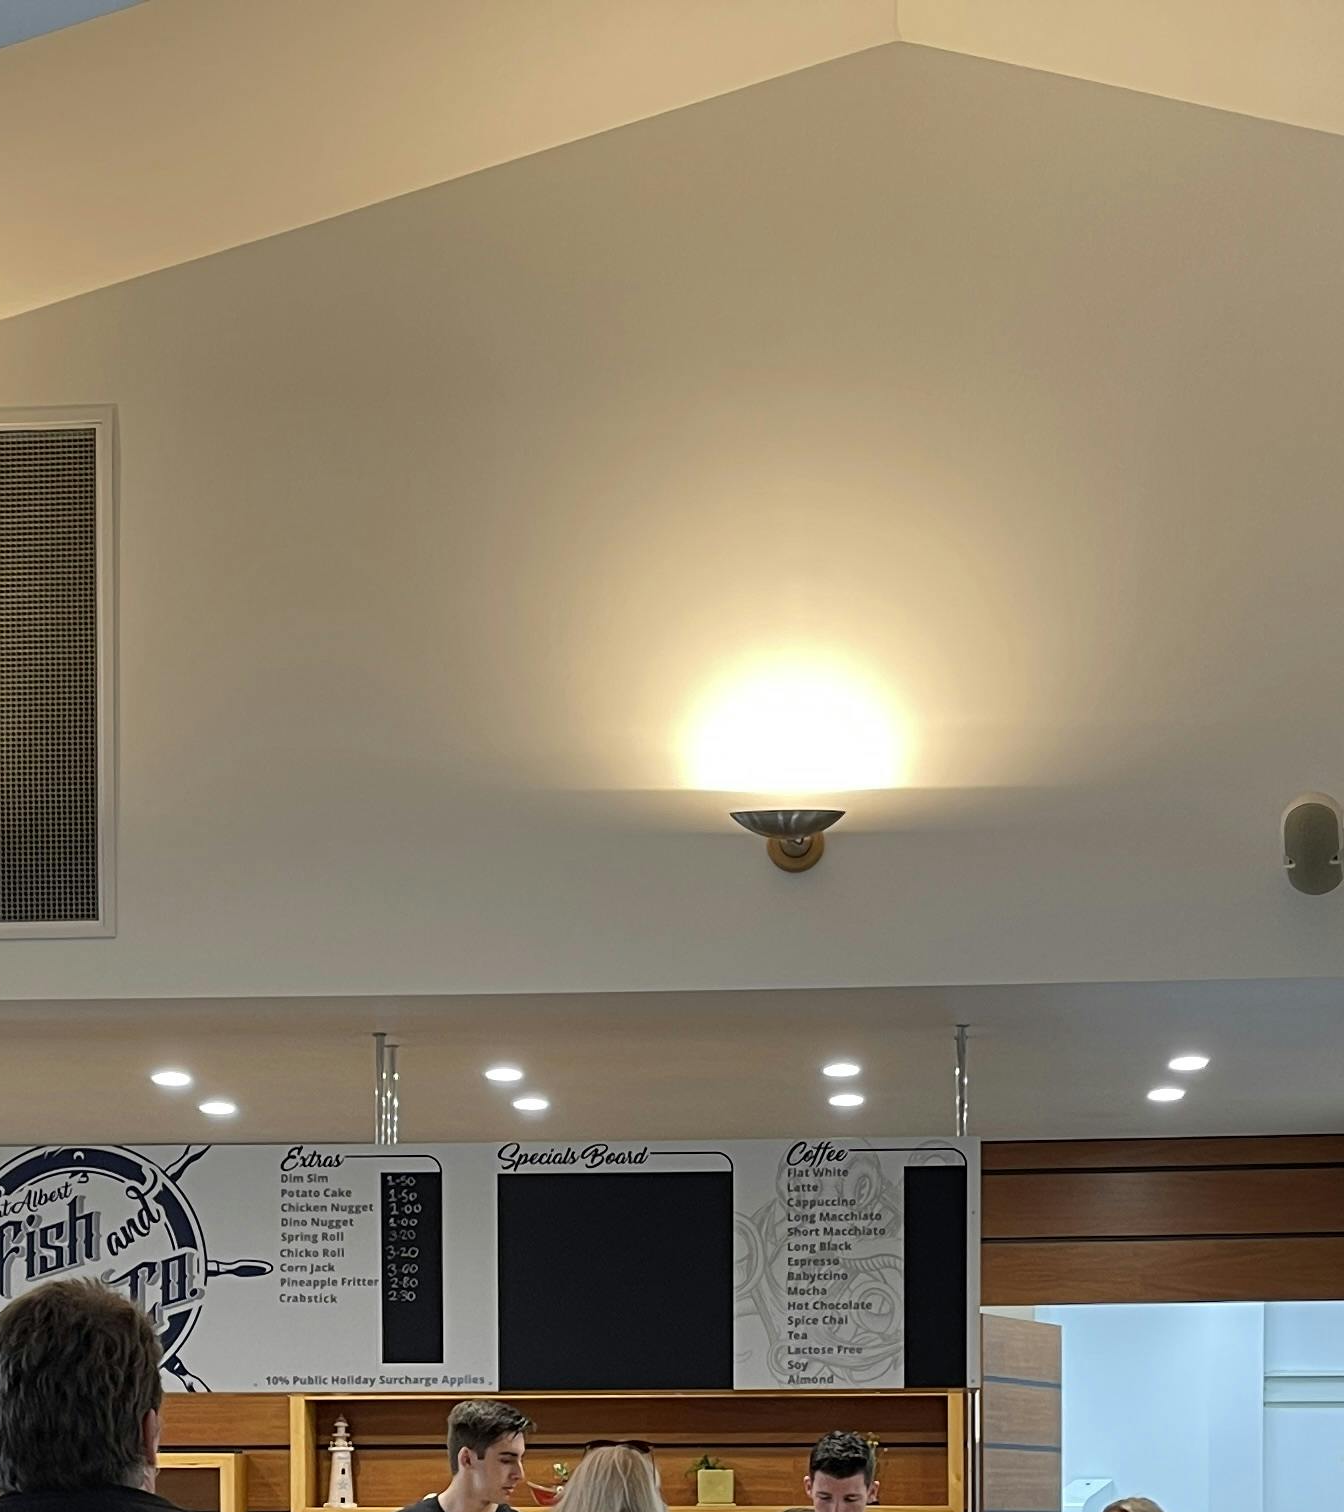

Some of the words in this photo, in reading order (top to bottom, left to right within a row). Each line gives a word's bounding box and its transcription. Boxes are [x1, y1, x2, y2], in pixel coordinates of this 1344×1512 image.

[280, 1144, 345, 1172] Extras
[497, 1142, 580, 1172] Specials
[580, 1143, 648, 1168] Board
[786, 1141, 849, 1167] Coffee
[280, 1174, 304, 1183] Dim
[307, 1174, 329, 1183] Sim
[787, 1168, 810, 1177] Flat
[813, 1168, 849, 1177] White
[280, 1189, 320, 1198] Potato
[323, 1188, 352, 1198] Cake
[787, 1183, 818, 1193] Latte
[10, 1181, 72, 1212] Albert
[280, 1203, 327, 1212] Chicken
[331, 1203, 374, 1215] Nugget
[787, 1197, 856, 1209] Cappuccino
[106, 1167, 162, 1256] and
[280, 1218, 307, 1227] Dino
[311, 1218, 354, 1229] Nugget
[787, 1212, 816, 1224] Long
[819, 1212, 882, 1221] Macchiato
[787, 1227, 820, 1237] Short
[823, 1226, 886, 1236] Macchiato
[280, 1232, 318, 1244] Spring
[321, 1232, 344, 1241] Roll
[280, 1249, 319, 1258] Chicko
[322, 1249, 344, 1258] Roll
[787, 1242, 816, 1254] Long
[819, 1241, 852, 1251] Black
[787, 1257, 840, 1268] Espresso
[280, 1263, 307, 1272] Corn
[310, 1263, 335, 1275] Jack
[280, 1278, 338, 1289] Pineapple
[341, 1277, 379, 1287] Fritter
[787, 1271, 849, 1284] Babyccino
[787, 1286, 827, 1296] Mocha
[279, 1293, 338, 1303] Crabstick
[787, 1301, 810, 1311] Hot
[812, 1300, 873, 1310] Chocolate
[787, 1315, 818, 1328] Spice
[822, 1315, 848, 1325] Chai
[787, 1331, 808, 1340] Tea
[787, 1345, 834, 1355] Lactose
[837, 1345, 863, 1354] Free
[787, 1360, 808, 1372] Soy
[266, 1375, 289, 1385] 10%
[292, 1375, 327, 1385] Public
[331, 1375, 376, 1387] Holiday
[379, 1375, 438, 1387] Surcharge
[441, 1375, 485, 1387] Applies
[787, 1374, 834, 1385] Almond
